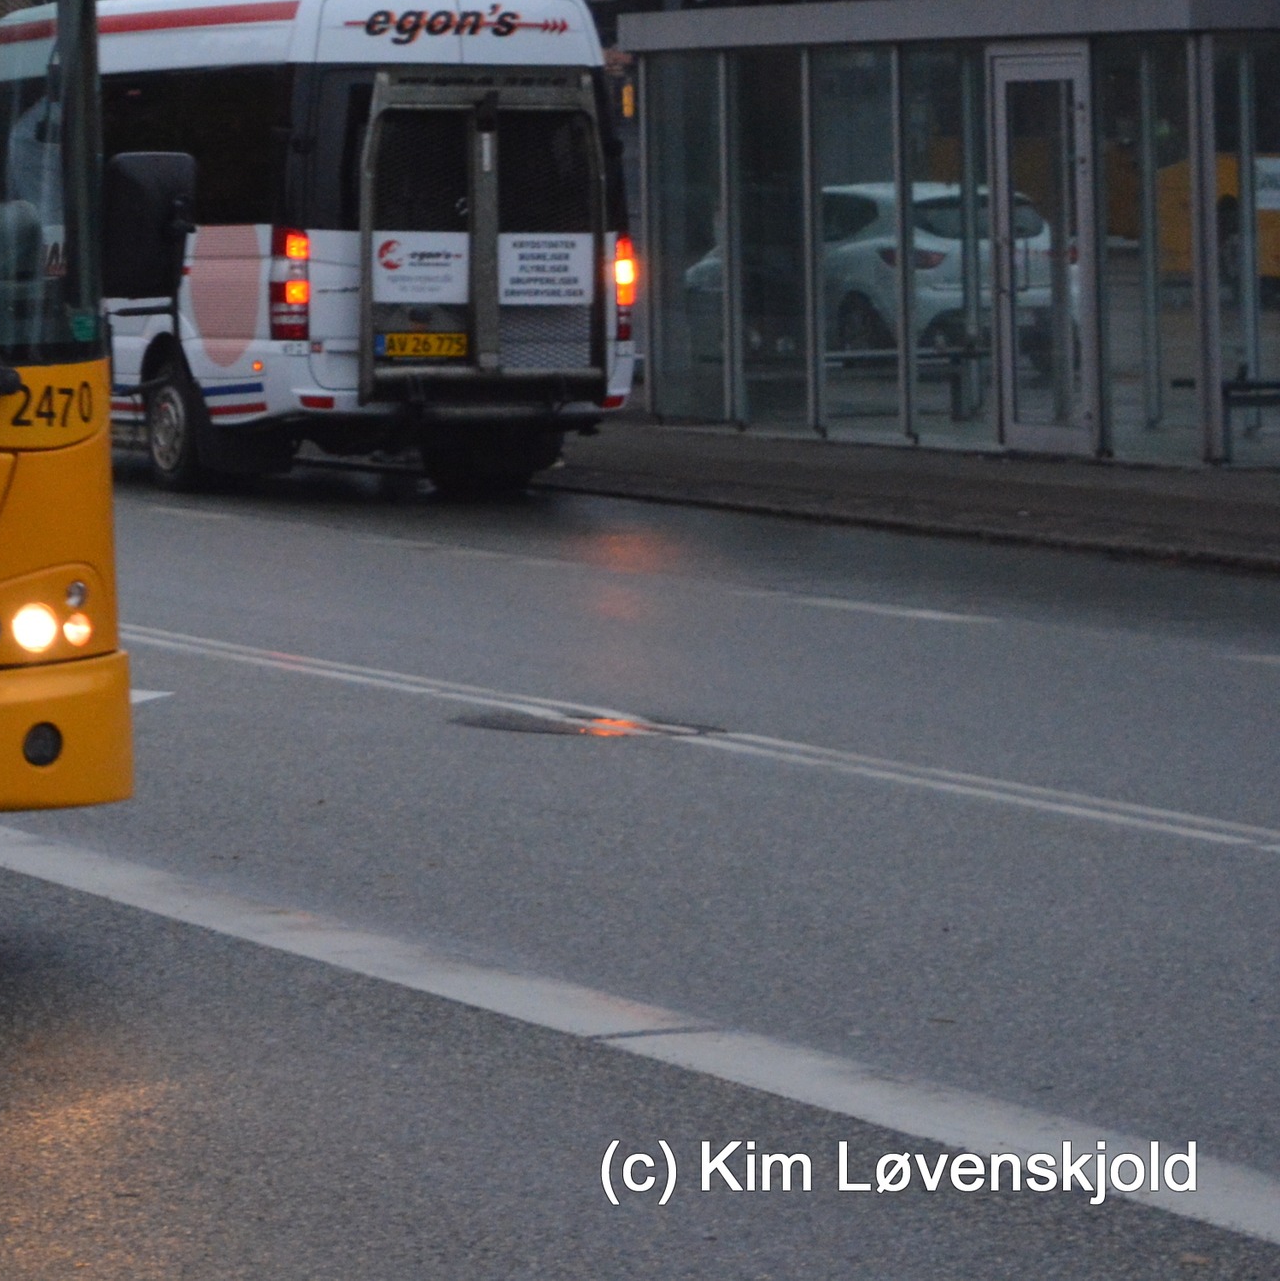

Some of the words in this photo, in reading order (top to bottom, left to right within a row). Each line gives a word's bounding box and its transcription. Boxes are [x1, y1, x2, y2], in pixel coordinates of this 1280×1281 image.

[364, 4, 520, 46] egon's
[412, 336, 432, 354] 26
[11, 381, 94, 429] 2470
